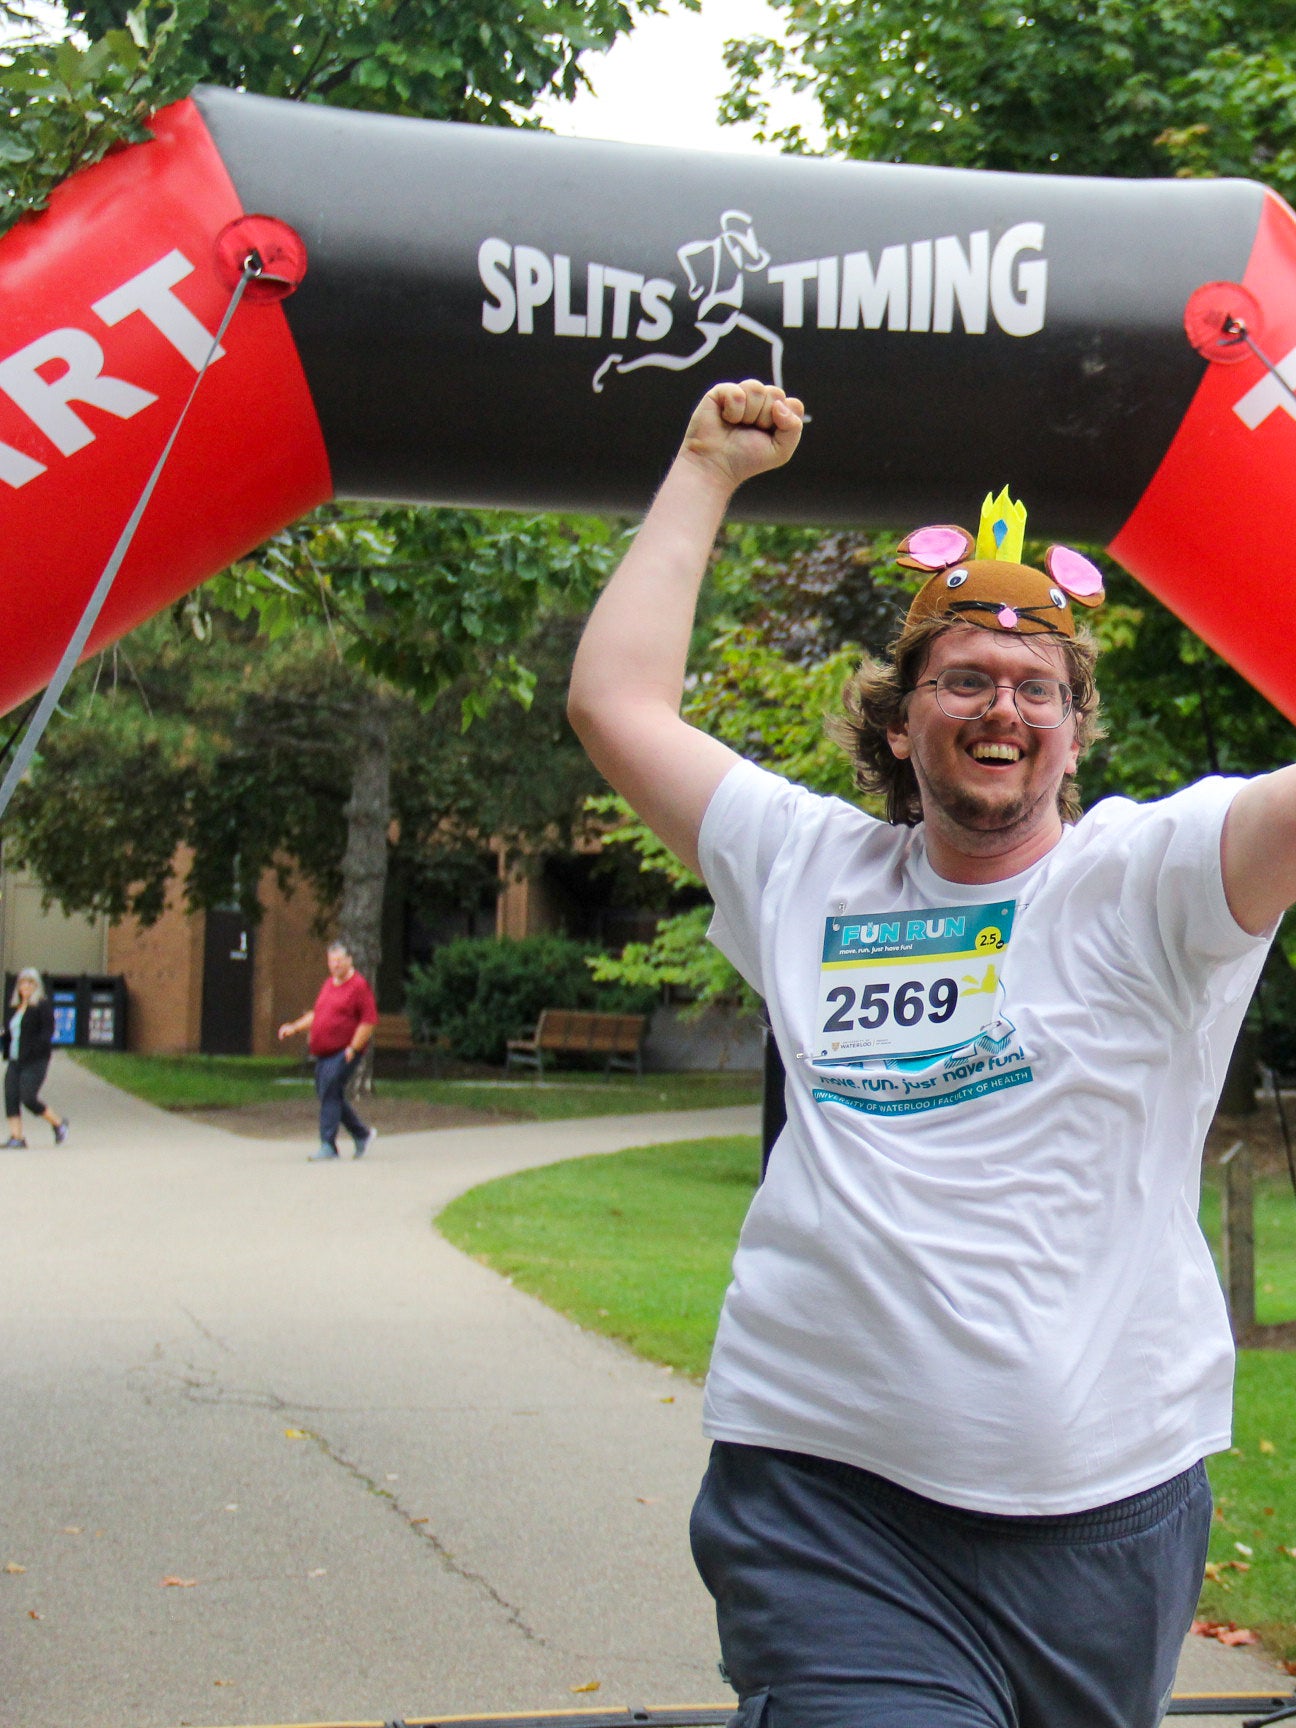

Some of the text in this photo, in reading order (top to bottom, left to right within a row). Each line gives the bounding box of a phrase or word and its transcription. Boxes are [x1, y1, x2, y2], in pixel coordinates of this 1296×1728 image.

[478, 221, 1048, 342] SPLITS TIMING
[0, 247, 227, 489] RT
[841, 915, 966, 946] FUN RUN
[979, 933, 997, 947] 2.5
[822, 977, 959, 1033] 2569
[840, 1041, 872, 1049] WATERLOO
[814, 1071, 1029, 1113] UNIVERSITY OF WATERLOO FACULTY OF HEALTH
